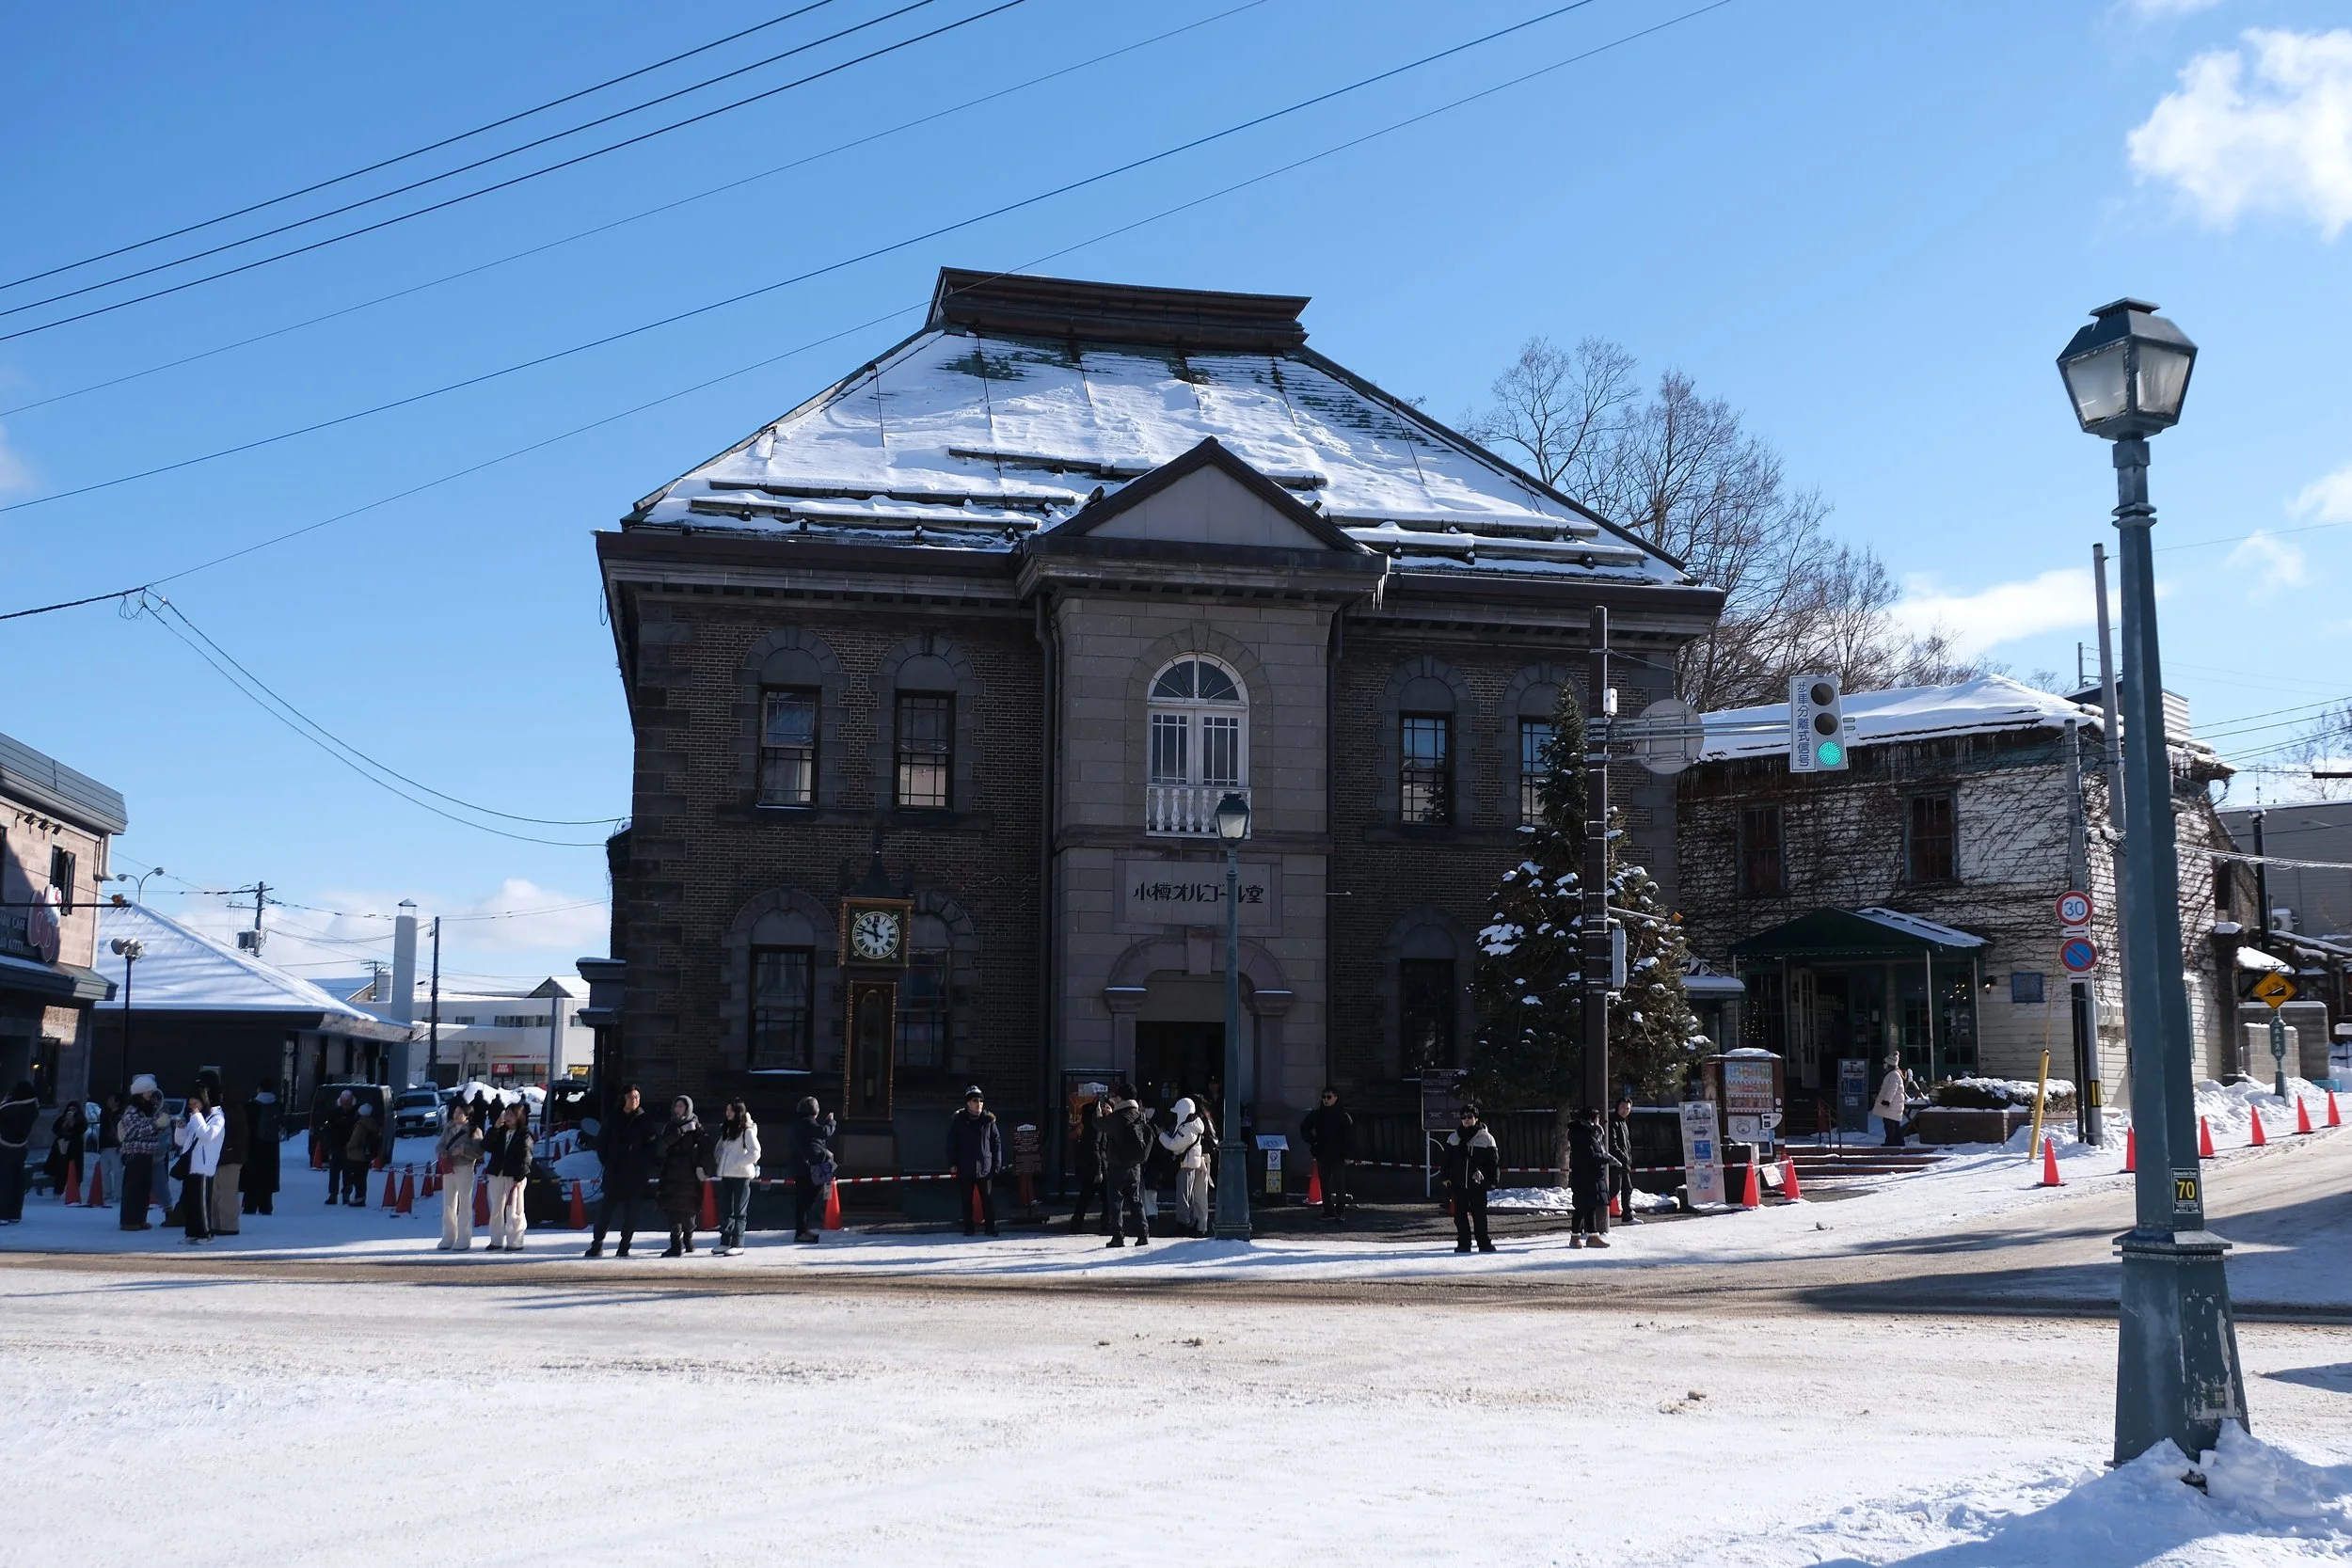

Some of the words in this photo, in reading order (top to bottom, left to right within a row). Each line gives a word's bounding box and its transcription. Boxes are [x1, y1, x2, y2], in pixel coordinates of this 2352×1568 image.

[1797, 681, 1810, 767] 歩車分離式信号
[2064, 900, 2086, 917] 30
[2176, 1180, 2196, 1199] 70
